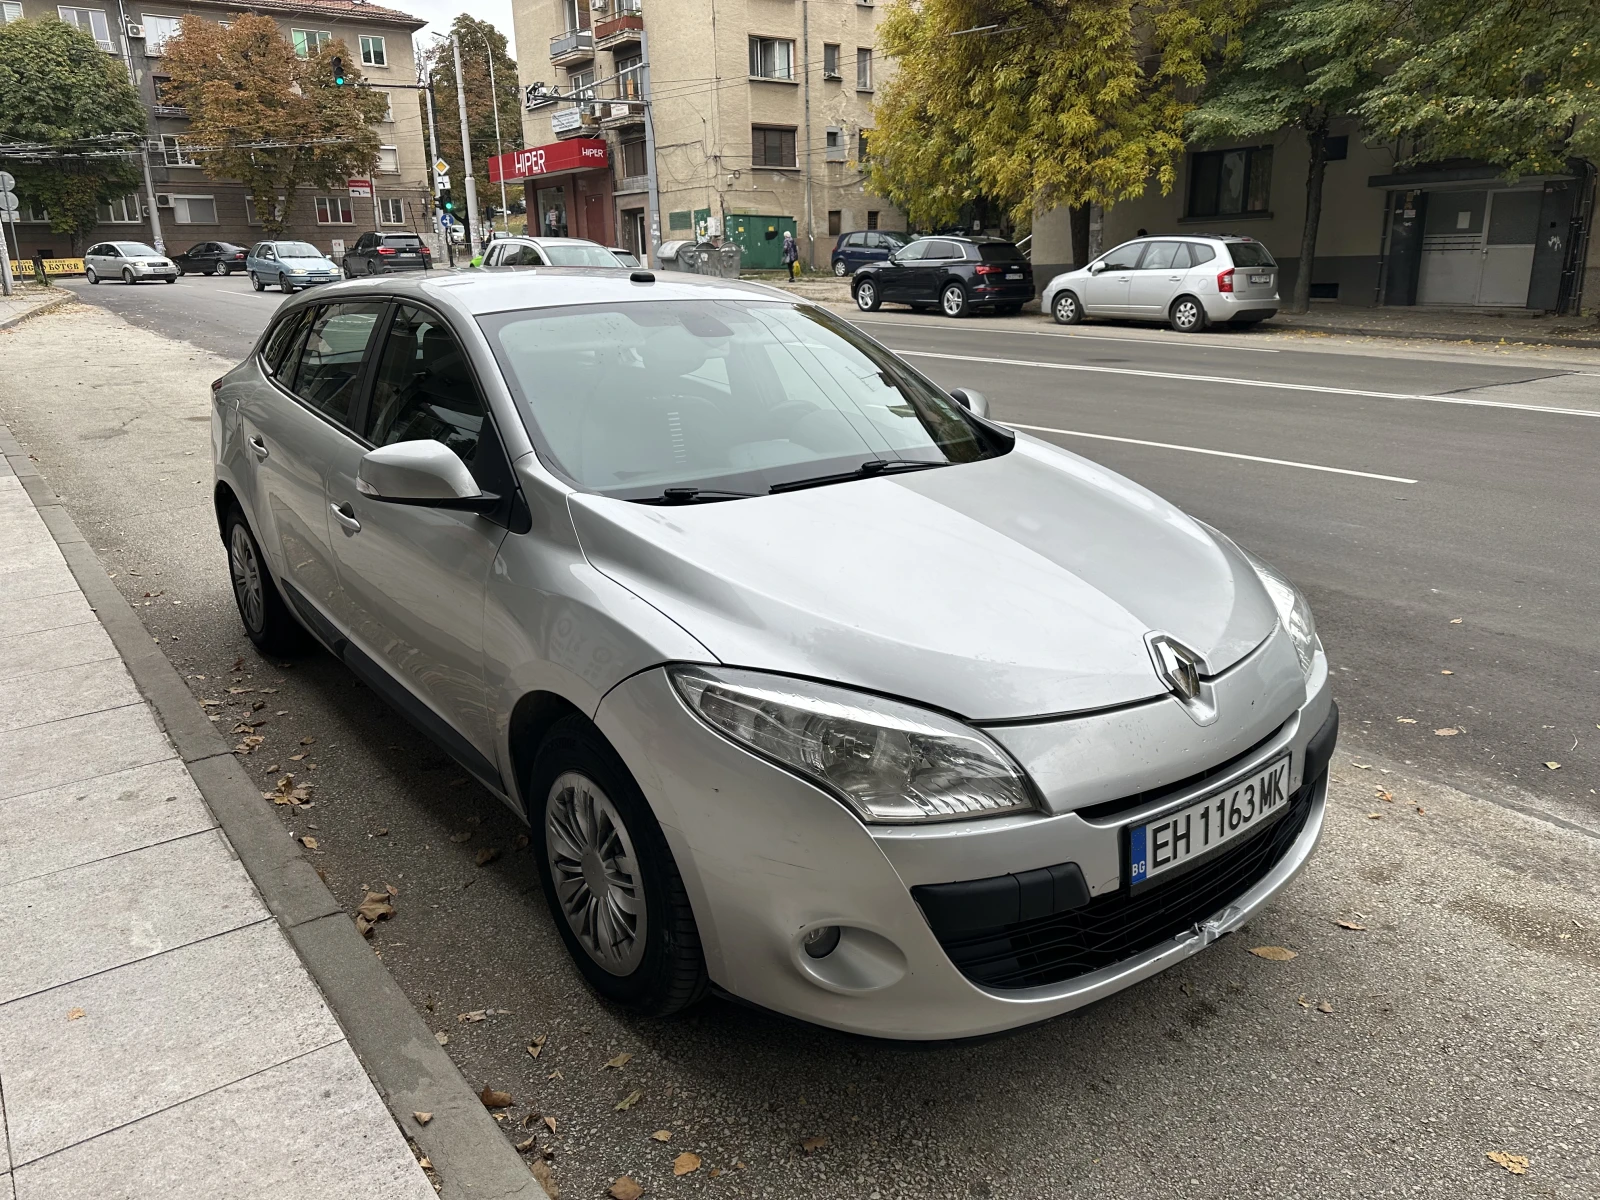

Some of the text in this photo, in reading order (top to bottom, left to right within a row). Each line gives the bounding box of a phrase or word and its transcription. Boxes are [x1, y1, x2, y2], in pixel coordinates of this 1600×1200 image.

[514, 150, 546, 176] HIPER
[582, 147, 603, 158] HIPER
[1152, 764, 1286, 869] EH 1163 MK
[1132, 860, 1146, 877] BG
